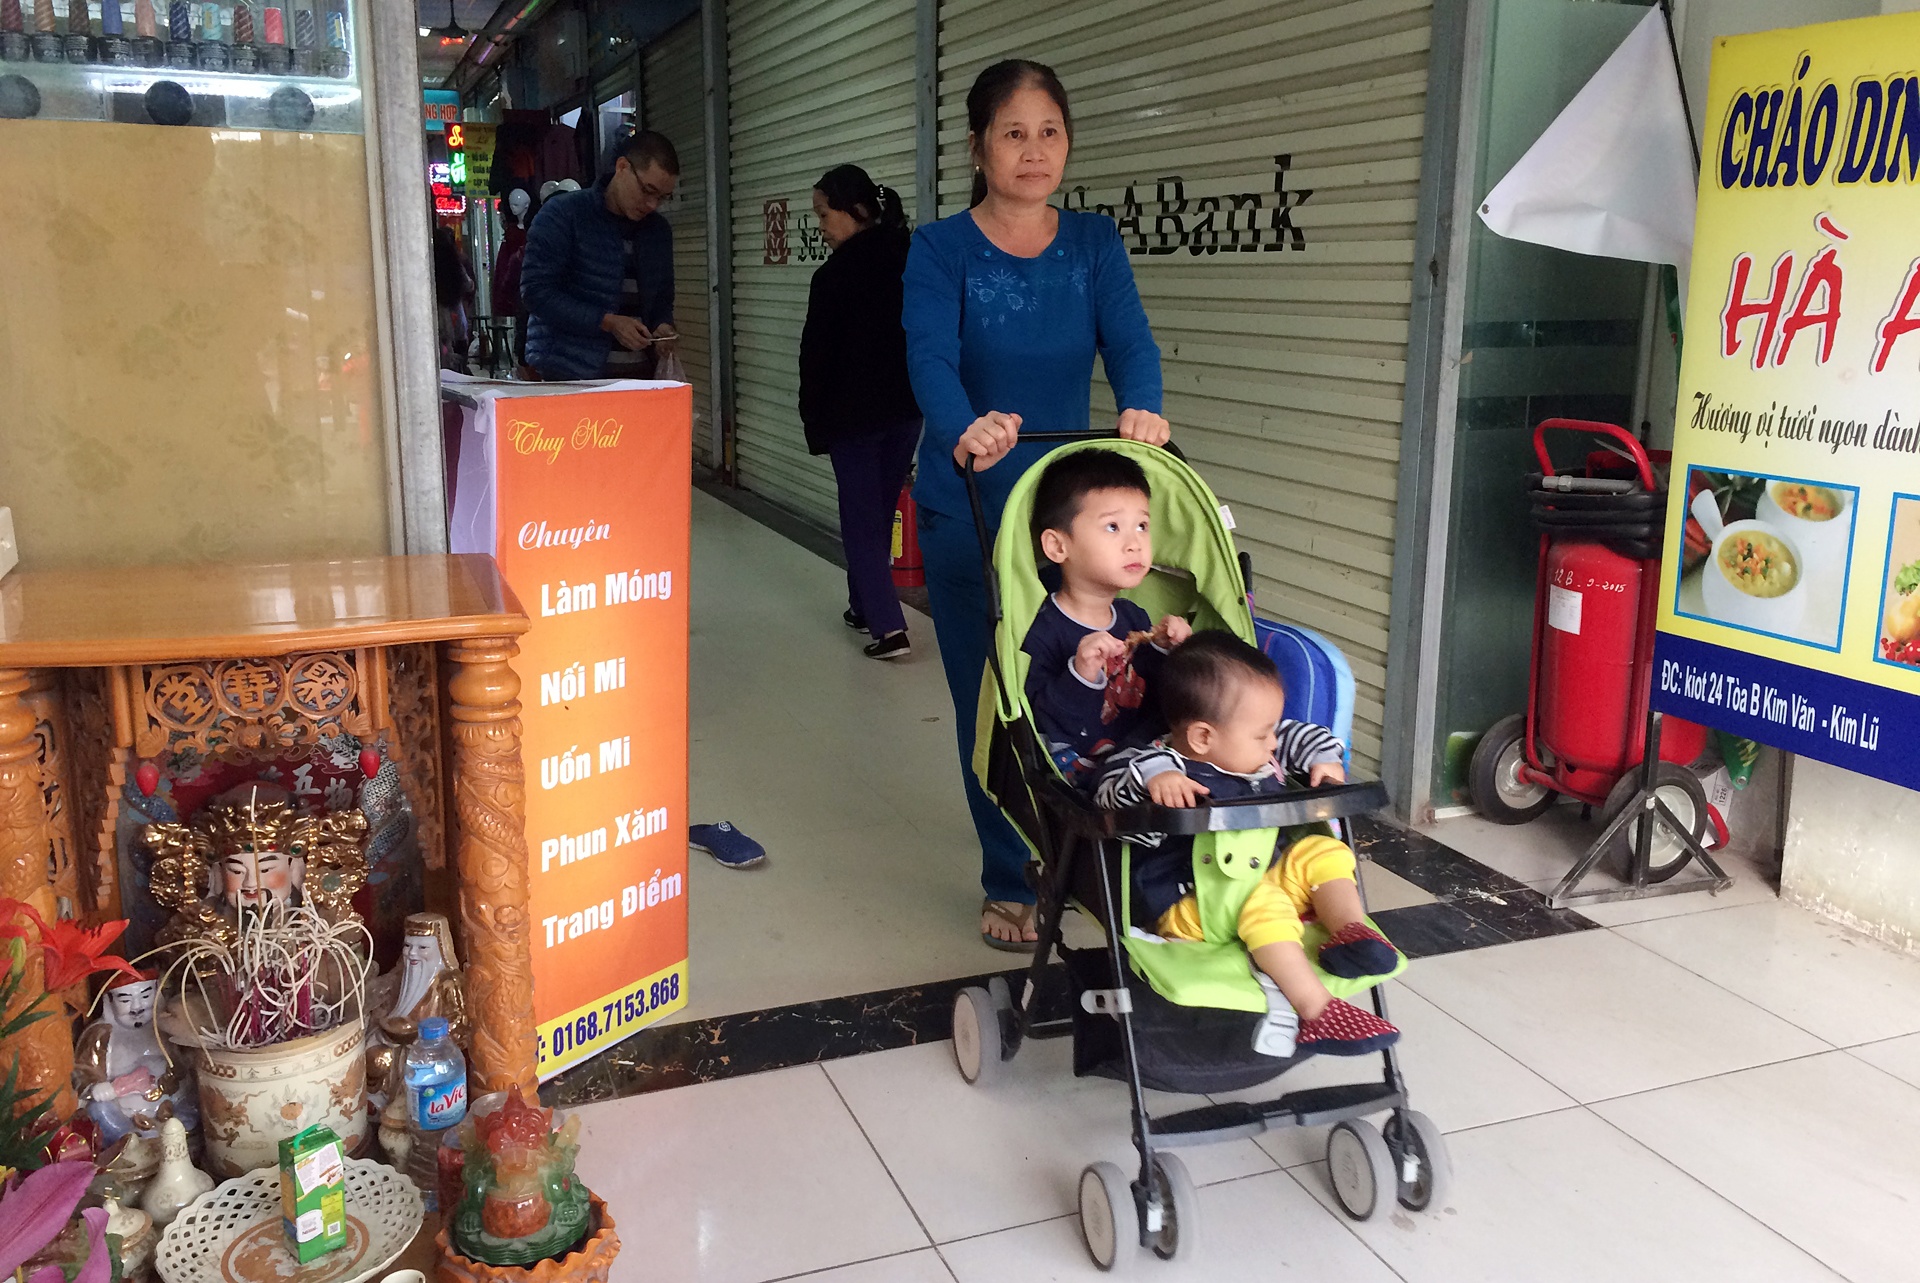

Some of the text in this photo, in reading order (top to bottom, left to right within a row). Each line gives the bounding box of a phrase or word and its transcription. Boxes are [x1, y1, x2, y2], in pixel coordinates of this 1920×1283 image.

[1719, 54, 1839, 190] CHÁO
[1063, 154, 1313, 256] ABank
[1722, 214, 1850, 370] HÀ
[506, 417, 624, 465] Thuy Nail
[1690, 391, 1752, 444] Hương
[1756, 401, 1777, 448] vị
[1777, 404, 1817, 442] tươi
[1818, 419, 1868, 455] ngon
[518, 519, 612, 550] Chuyên
[541, 569, 672, 617] Làm Móng
[540, 656, 626, 707] Nối Mi
[1661, 659, 1683, 695] ĐC:
[1684, 666, 1707, 702] kiot
[1707, 671, 1723, 706] 24
[1726, 676, 1748, 714] Tòa
[1749, 682, 1760, 716] B
[1762, 686, 1788, 725] Kim
[1791, 693, 1816, 732] Văn
[1829, 704, 1857, 745] Kim
[1859, 713, 1880, 751] Lũ
[540, 735, 631, 790] Uốn Mi
[541, 806, 668, 873] Phun Xăm
[542, 868, 682, 949] Trang Điểm
[552, 972, 679, 1057] 0168.7153.868
